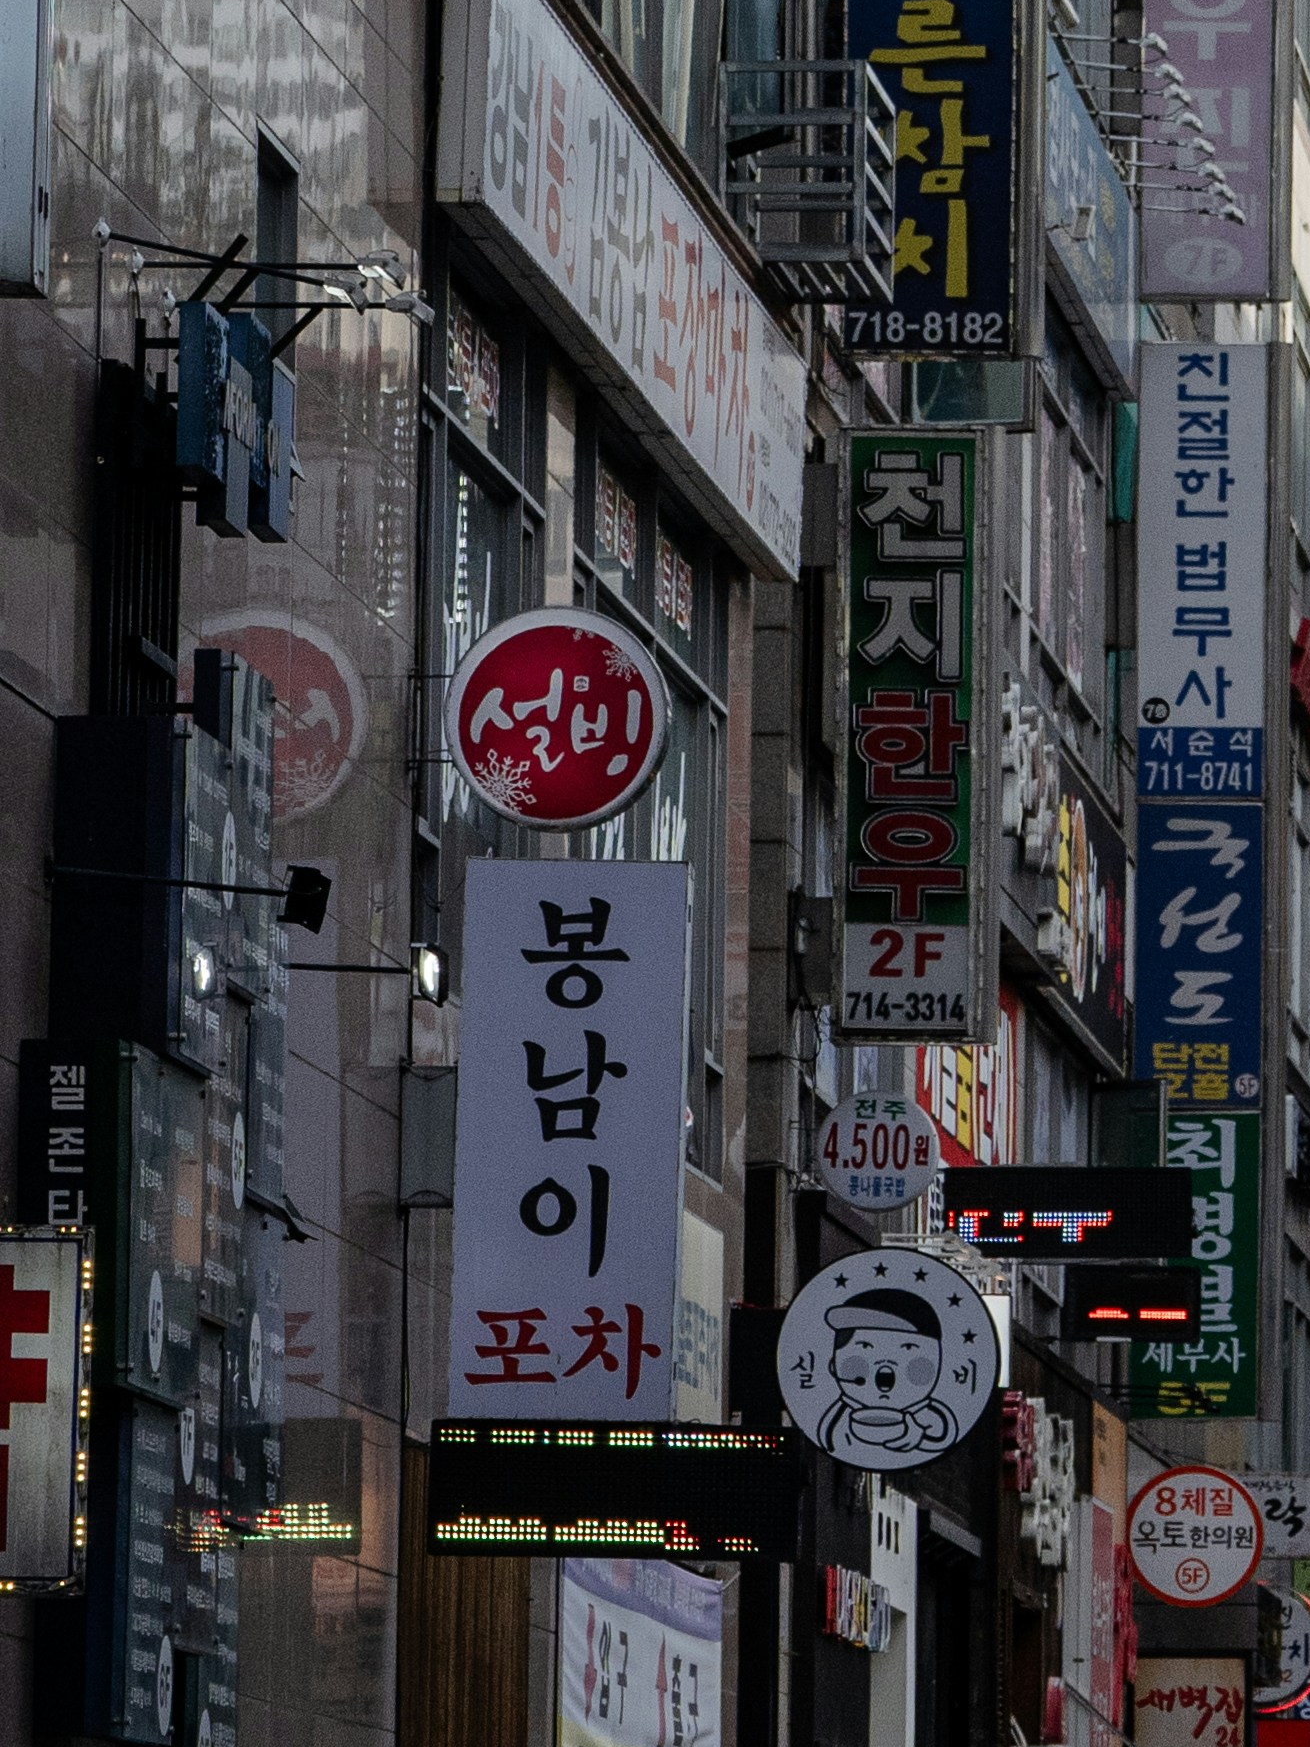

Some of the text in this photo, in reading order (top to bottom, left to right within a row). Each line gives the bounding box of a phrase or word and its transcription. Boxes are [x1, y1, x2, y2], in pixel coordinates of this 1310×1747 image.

[848, 312, 1003, 345] 718-8182
[654, 215, 750, 501] 포장마차
[1173, 353, 1234, 719] 친절한 법무사
[853, 452, 969, 923] 천지한우
[470, 668, 643, 776] 설빙
[1149, 731, 1255, 758] 서순석
[1145, 761, 1254, 792] 711-8741
[1152, 816, 1250, 1026] 국선도
[869, 929, 943, 978] 2F
[846, 992, 965, 1024] 714-3314
[520, 897, 630, 1279] 봉남이
[855, 1098, 907, 1120] 전주
[822, 1123, 931, 1174] 4.500원
[465, 1303, 663, 1400] 포차
[1155, 1486, 1234, 1519] 8체질
[1181, 1566, 1204, 1586] 5F
